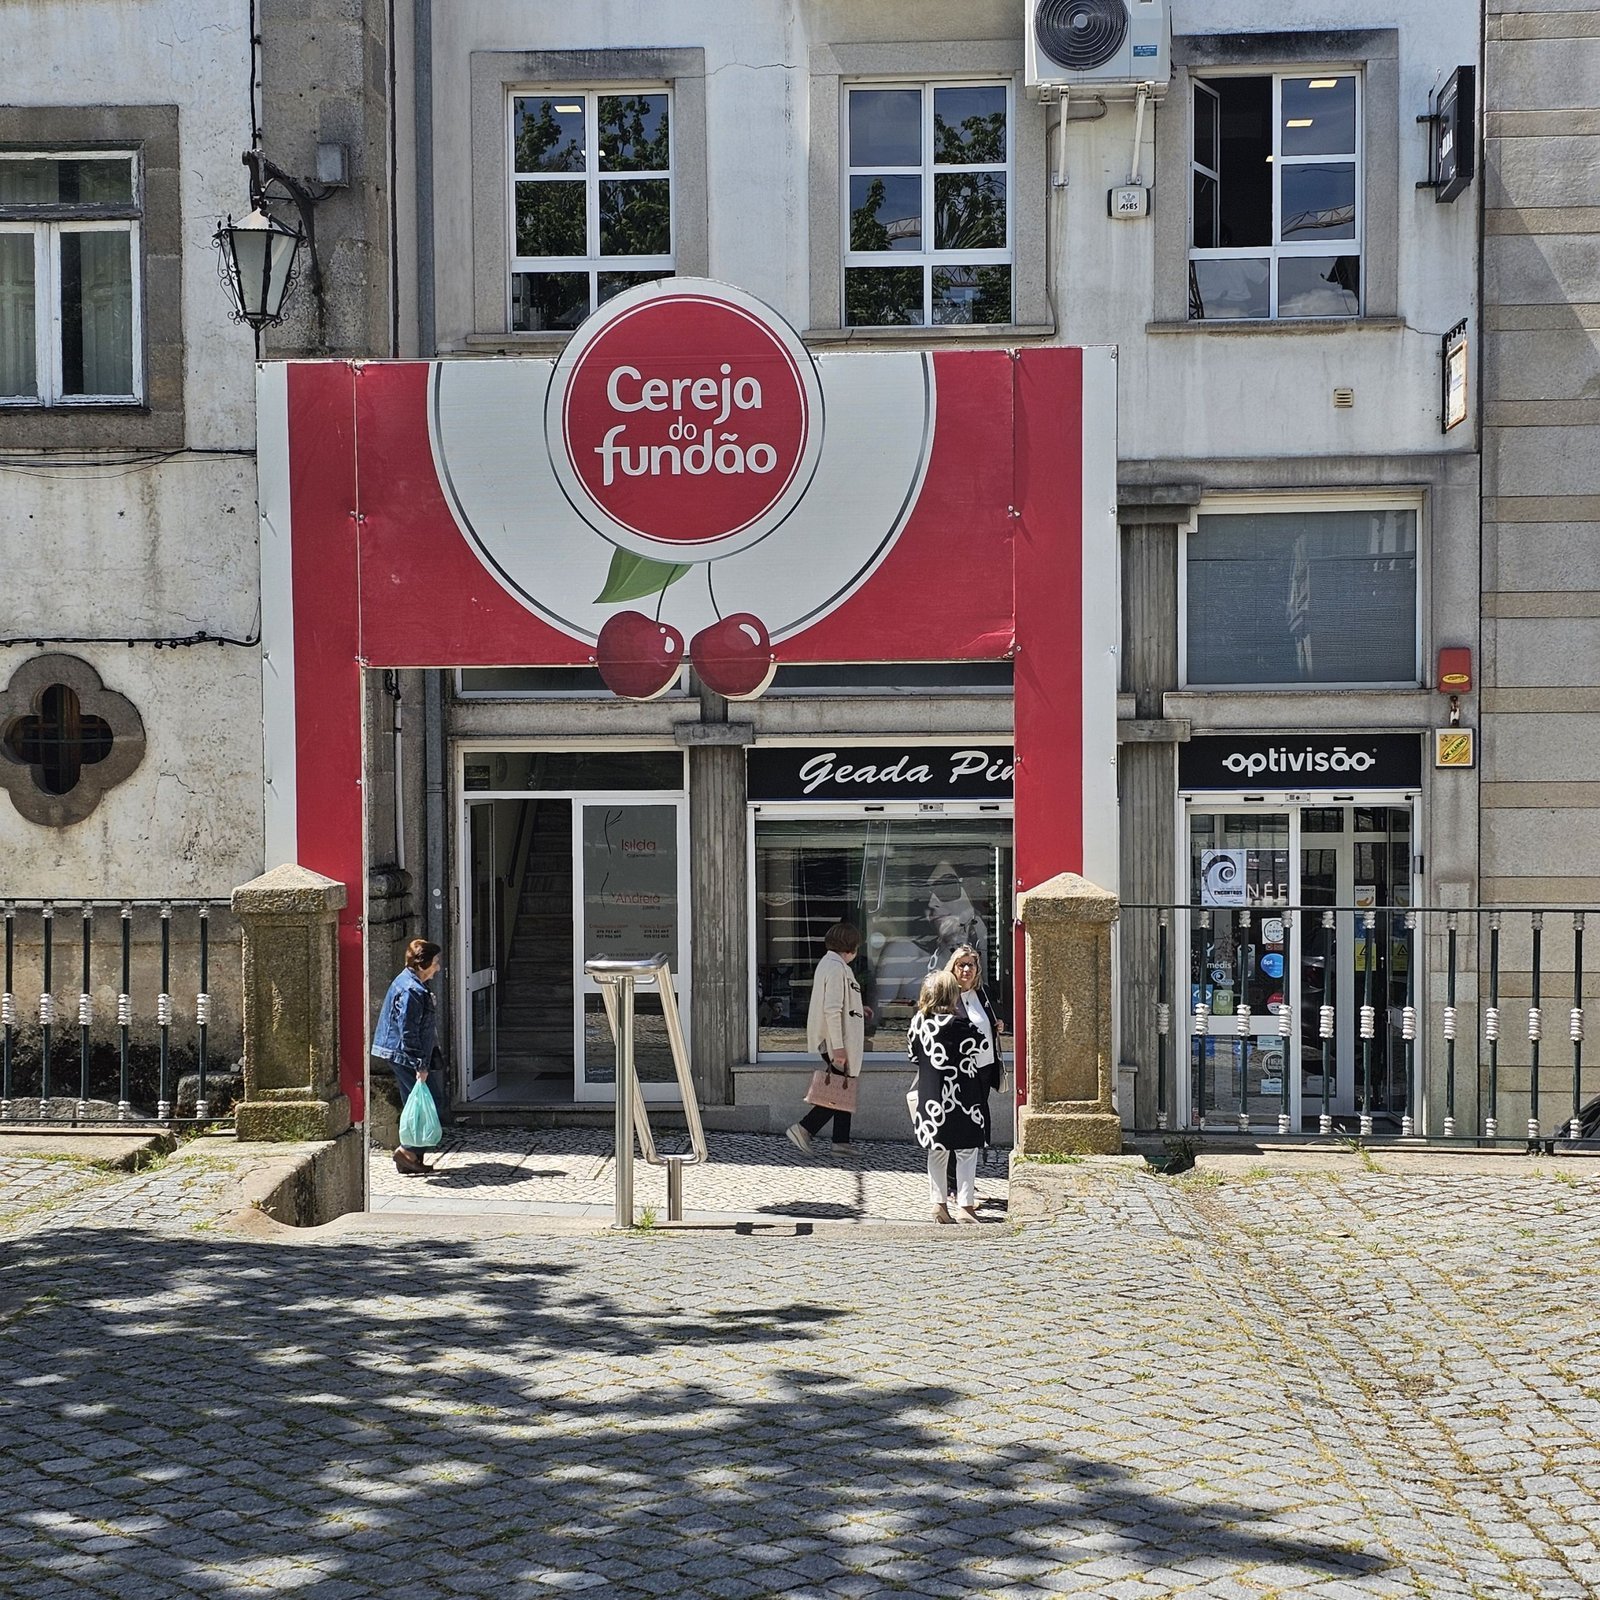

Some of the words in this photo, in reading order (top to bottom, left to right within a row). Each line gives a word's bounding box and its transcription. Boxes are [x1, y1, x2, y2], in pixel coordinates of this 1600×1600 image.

[606, 363, 762, 425] Cereja
[668, 416, 697, 441] do
[594, 425, 778, 486] fundão
[799, 752, 933, 794] Geada
[621, 838, 656, 851] Isilda
